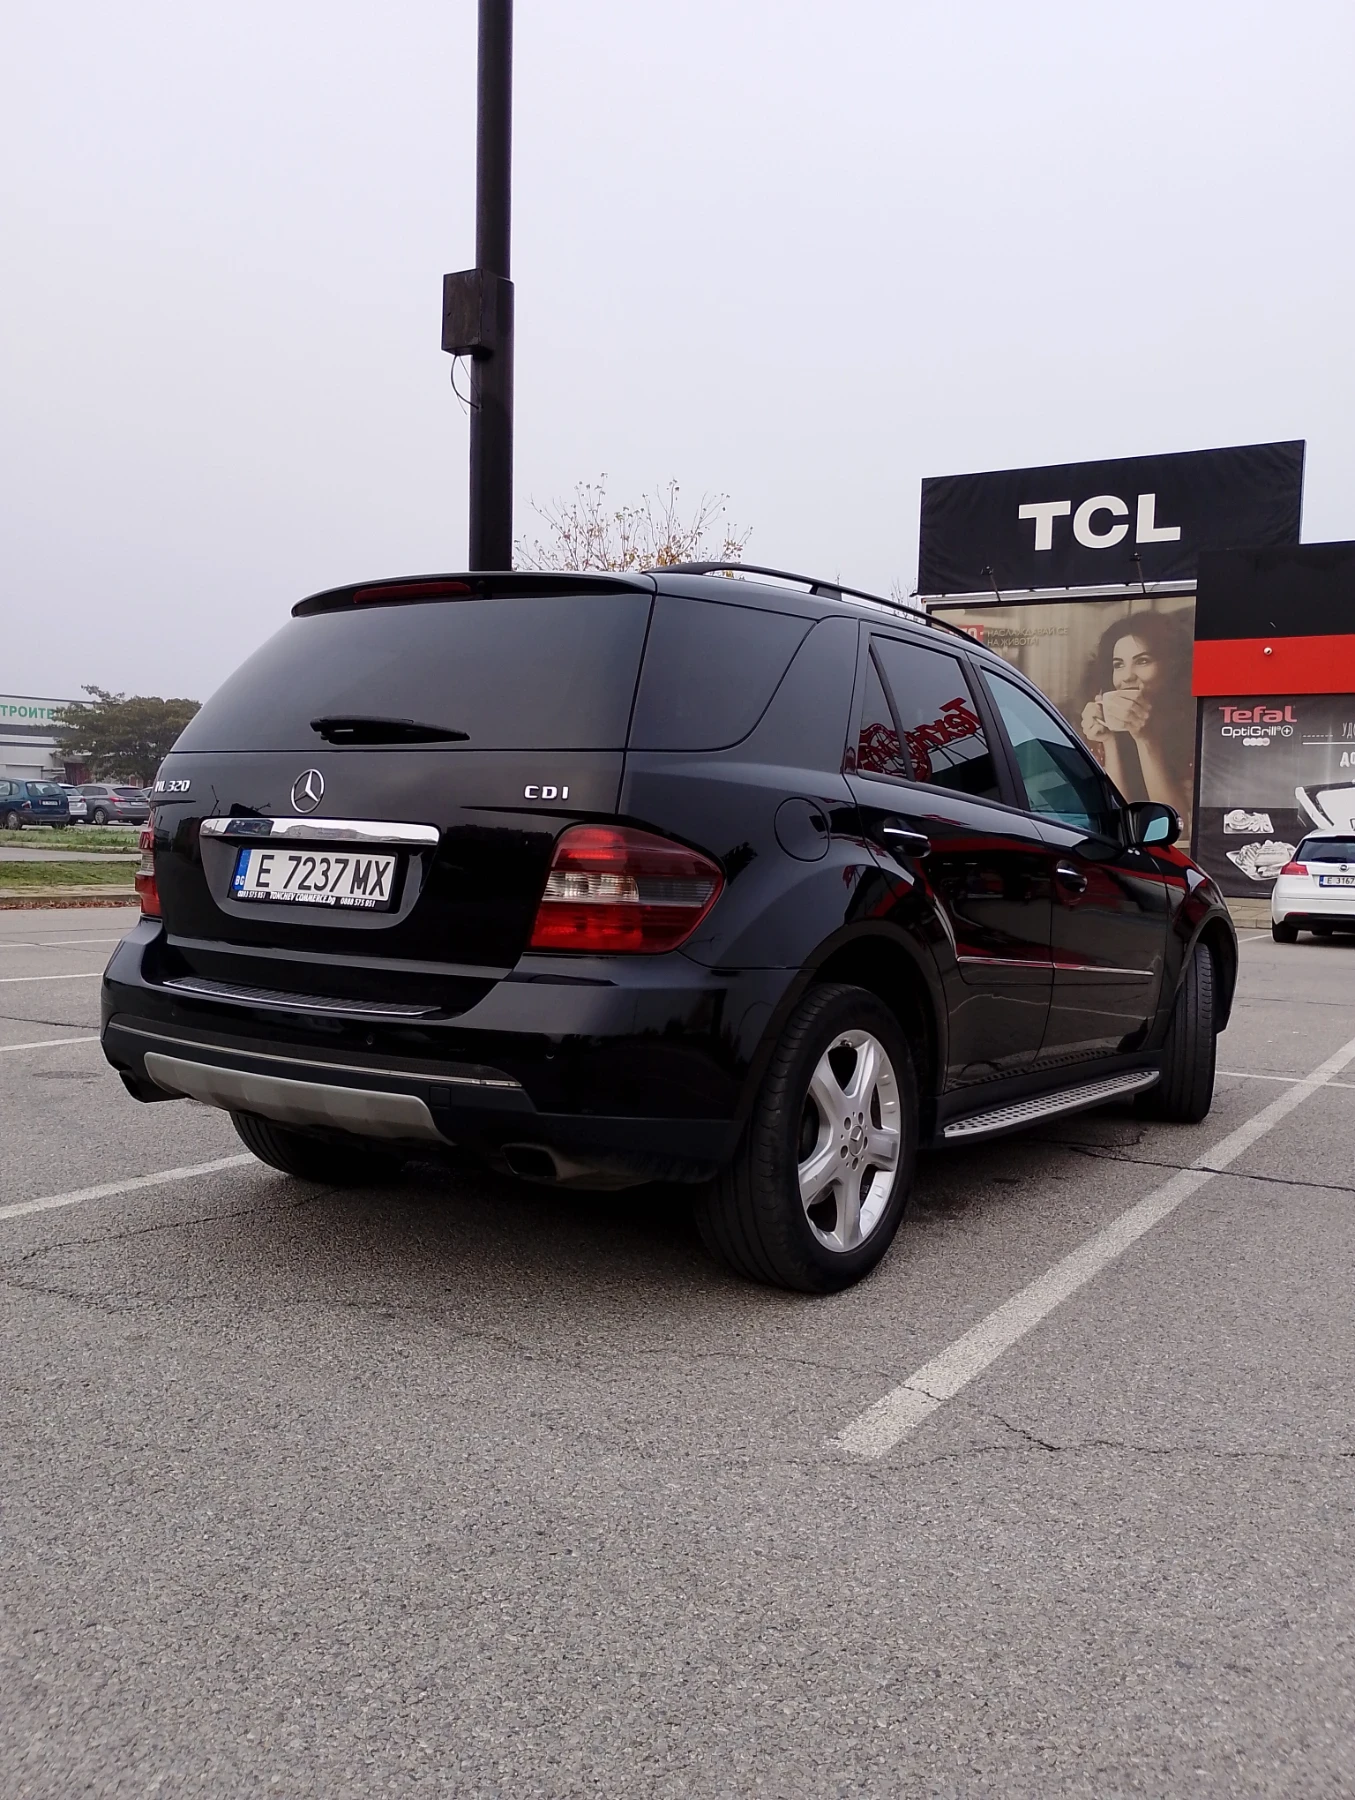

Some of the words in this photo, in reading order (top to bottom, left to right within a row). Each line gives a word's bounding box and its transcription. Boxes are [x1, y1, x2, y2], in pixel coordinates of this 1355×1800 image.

[1018, 493, 1181, 551] TCL
[987, 627, 1056, 638] НАСЛАЖДАВАЙ
[1056, 626, 1069, 636] СЕ
[987, 639, 1000, 647] НА
[1219, 705, 1297, 723] Tefal
[167, 780, 191, 792] 320
[524, 785, 569, 799] CDI
[235, 875, 245, 886] BG
[255, 854, 275, 888] E
[283, 855, 349, 893] 7237
[349, 859, 391, 897] MX
[269, 890, 296, 902] TONCHEV
